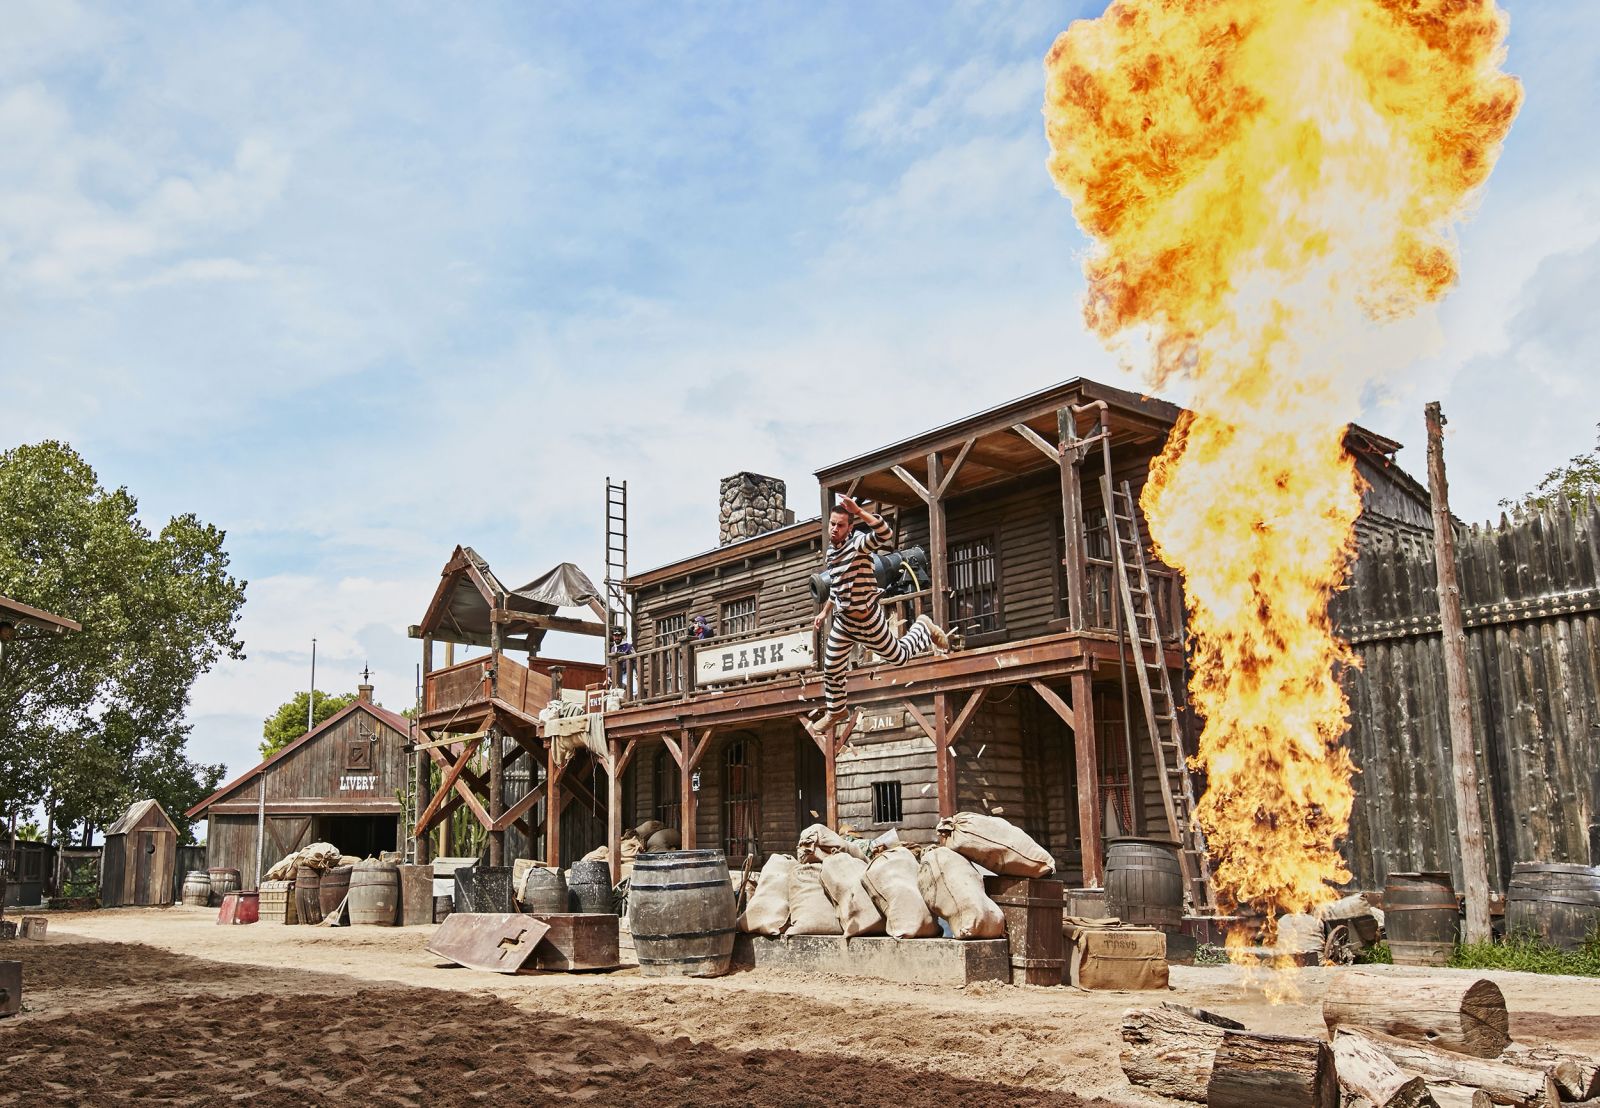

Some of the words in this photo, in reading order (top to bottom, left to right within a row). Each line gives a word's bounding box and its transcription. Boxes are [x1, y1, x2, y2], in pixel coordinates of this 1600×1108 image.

[721, 643, 784, 672] BANK
[870, 716, 894, 730] JAIL
[340, 776, 375, 790] LIVERY
